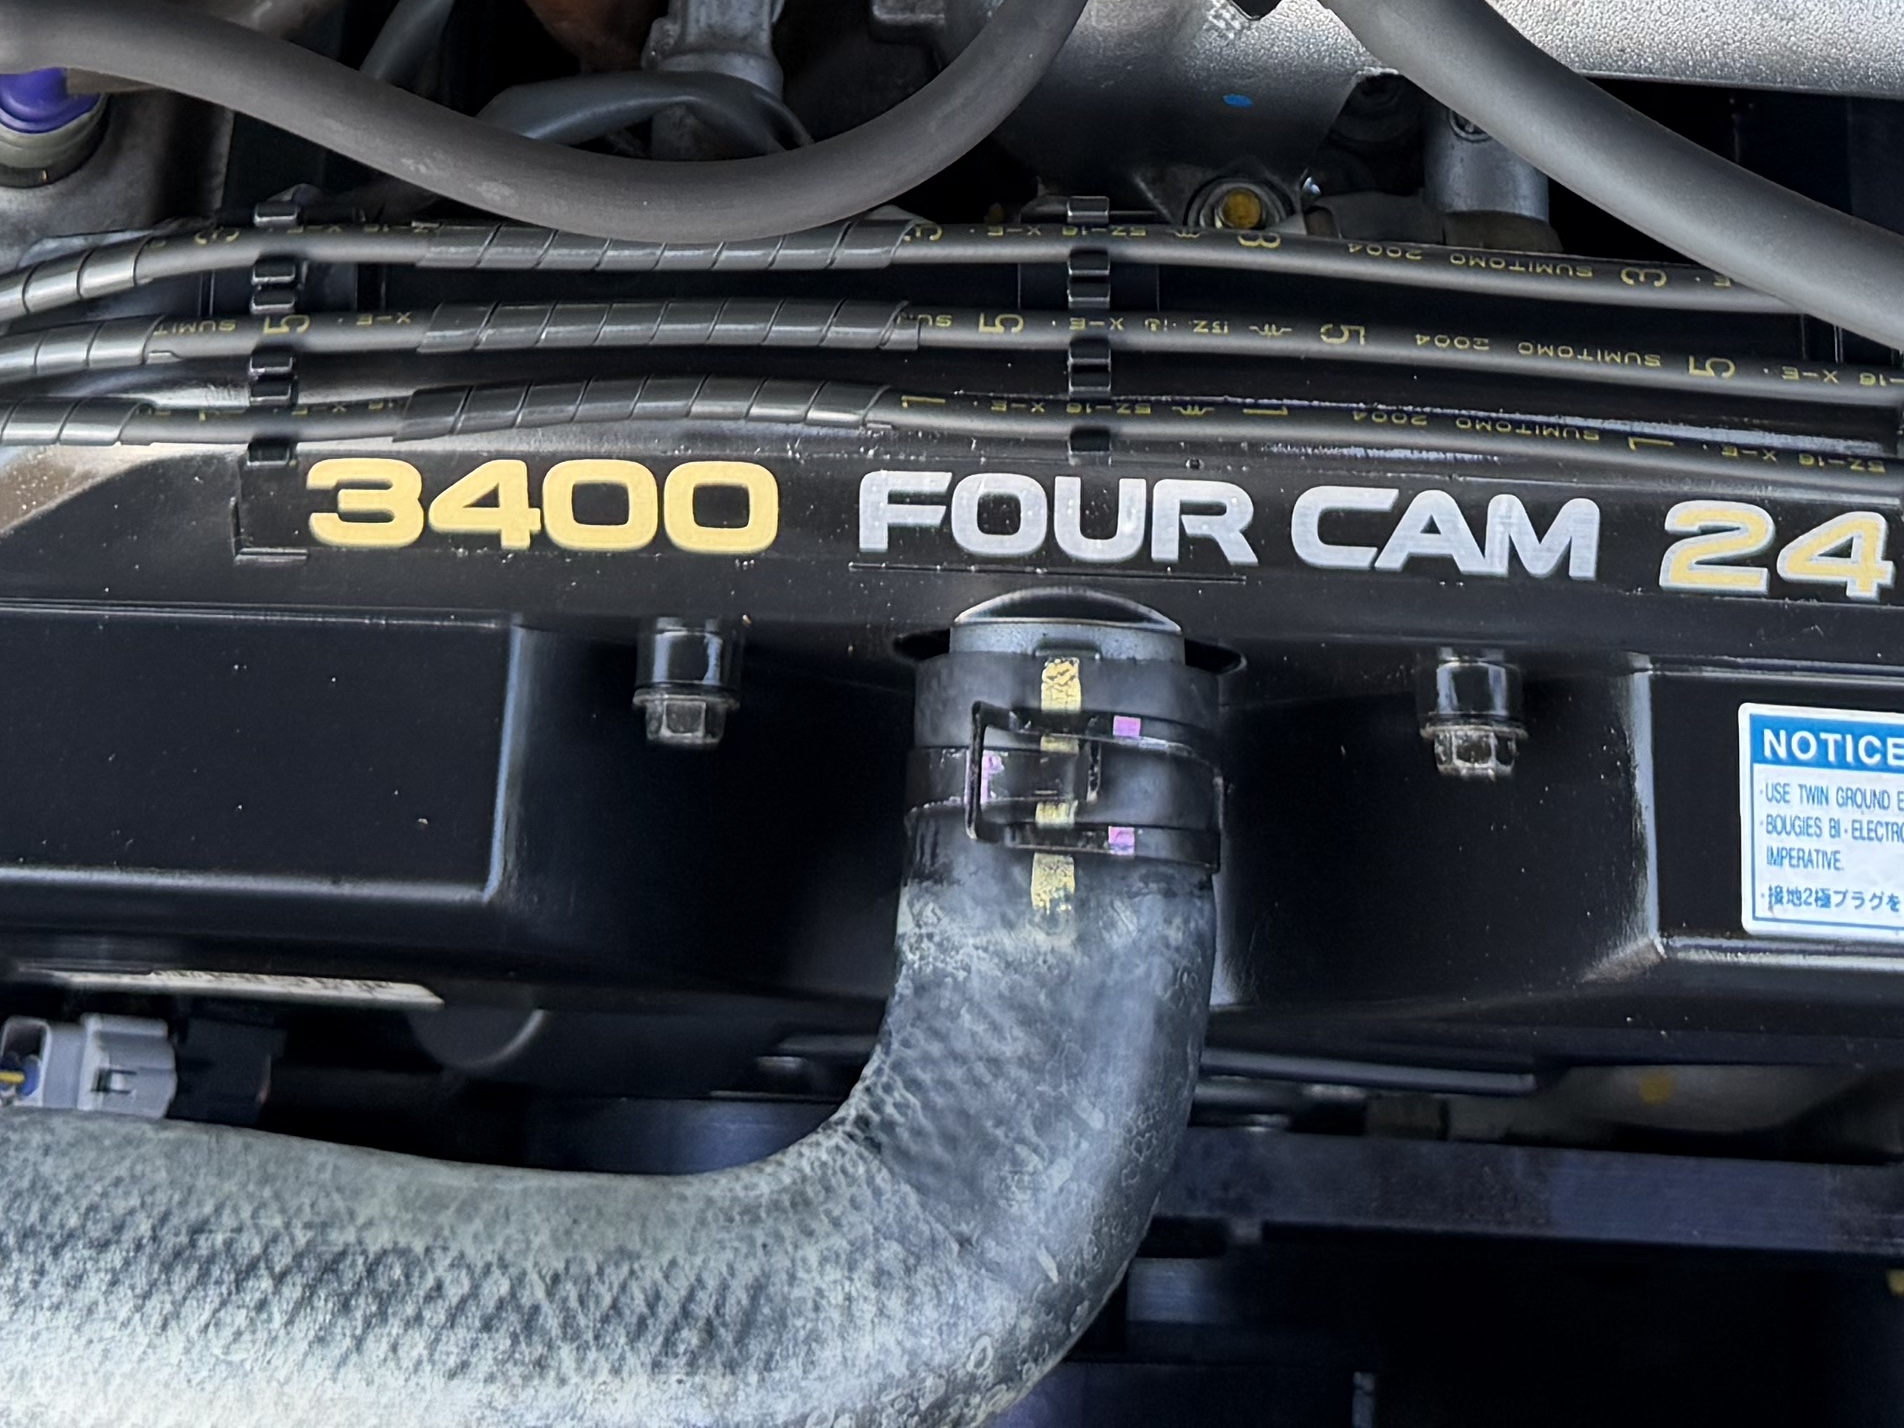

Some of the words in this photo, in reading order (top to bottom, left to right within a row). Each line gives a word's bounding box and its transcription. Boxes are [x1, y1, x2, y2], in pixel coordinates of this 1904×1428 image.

[1347, 242, 1423, 259] 2004
[1448, 252, 1593, 278] SUMITOMO
[1414, 333, 1490, 350] 2004
[1517, 341, 1661, 368] SUMITOMO
[1351, 408, 1429, 426] 2004
[1455, 416, 1600, 442] SUMITOMO
[304, 457, 782, 557] 3400
[856, 468, 1259, 567] FOUR
[1290, 485, 1600, 584] CAM
[1658, 500, 1897, 603] 24
[1765, 783, 1791, 804] USE
[1798, 785, 1829, 805] TWIN
[1836, 787, 1891, 810] GROUND
[1766, 816, 1822, 839] BOUGIES
